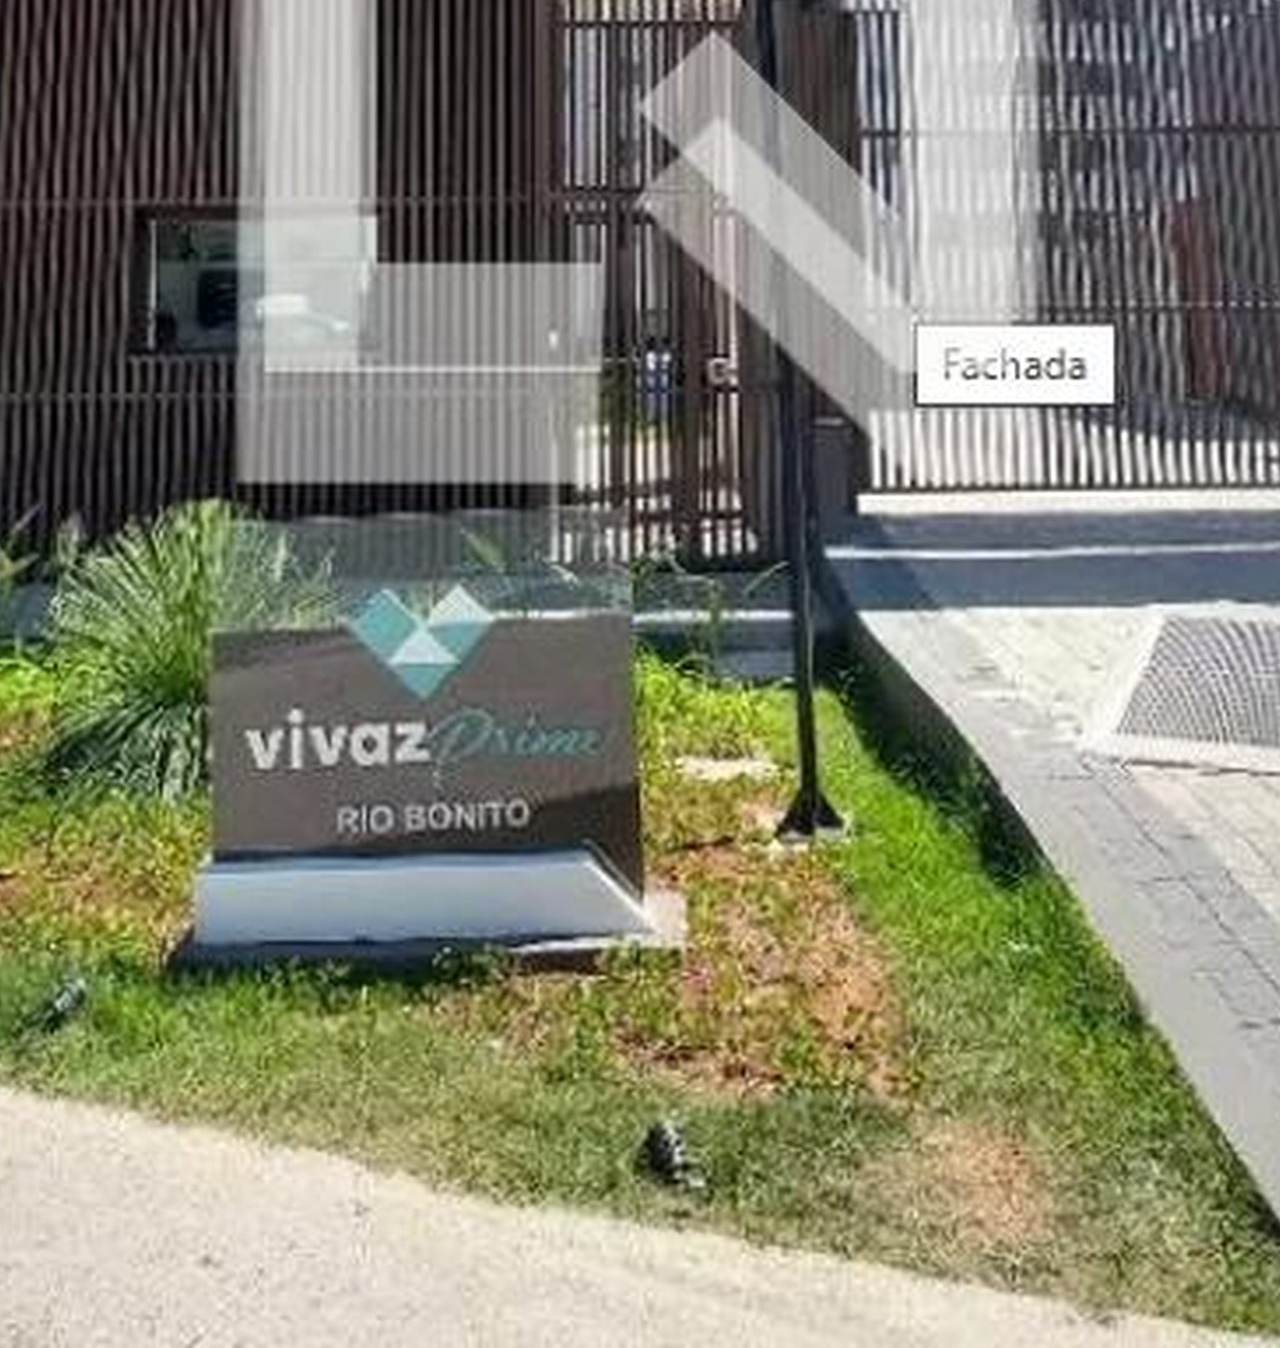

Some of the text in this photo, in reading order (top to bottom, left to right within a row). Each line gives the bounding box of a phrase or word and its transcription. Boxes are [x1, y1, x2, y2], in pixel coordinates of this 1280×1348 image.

[244, 708, 431, 770] vivaz
[335, 798, 530, 835] RIO BONITO
